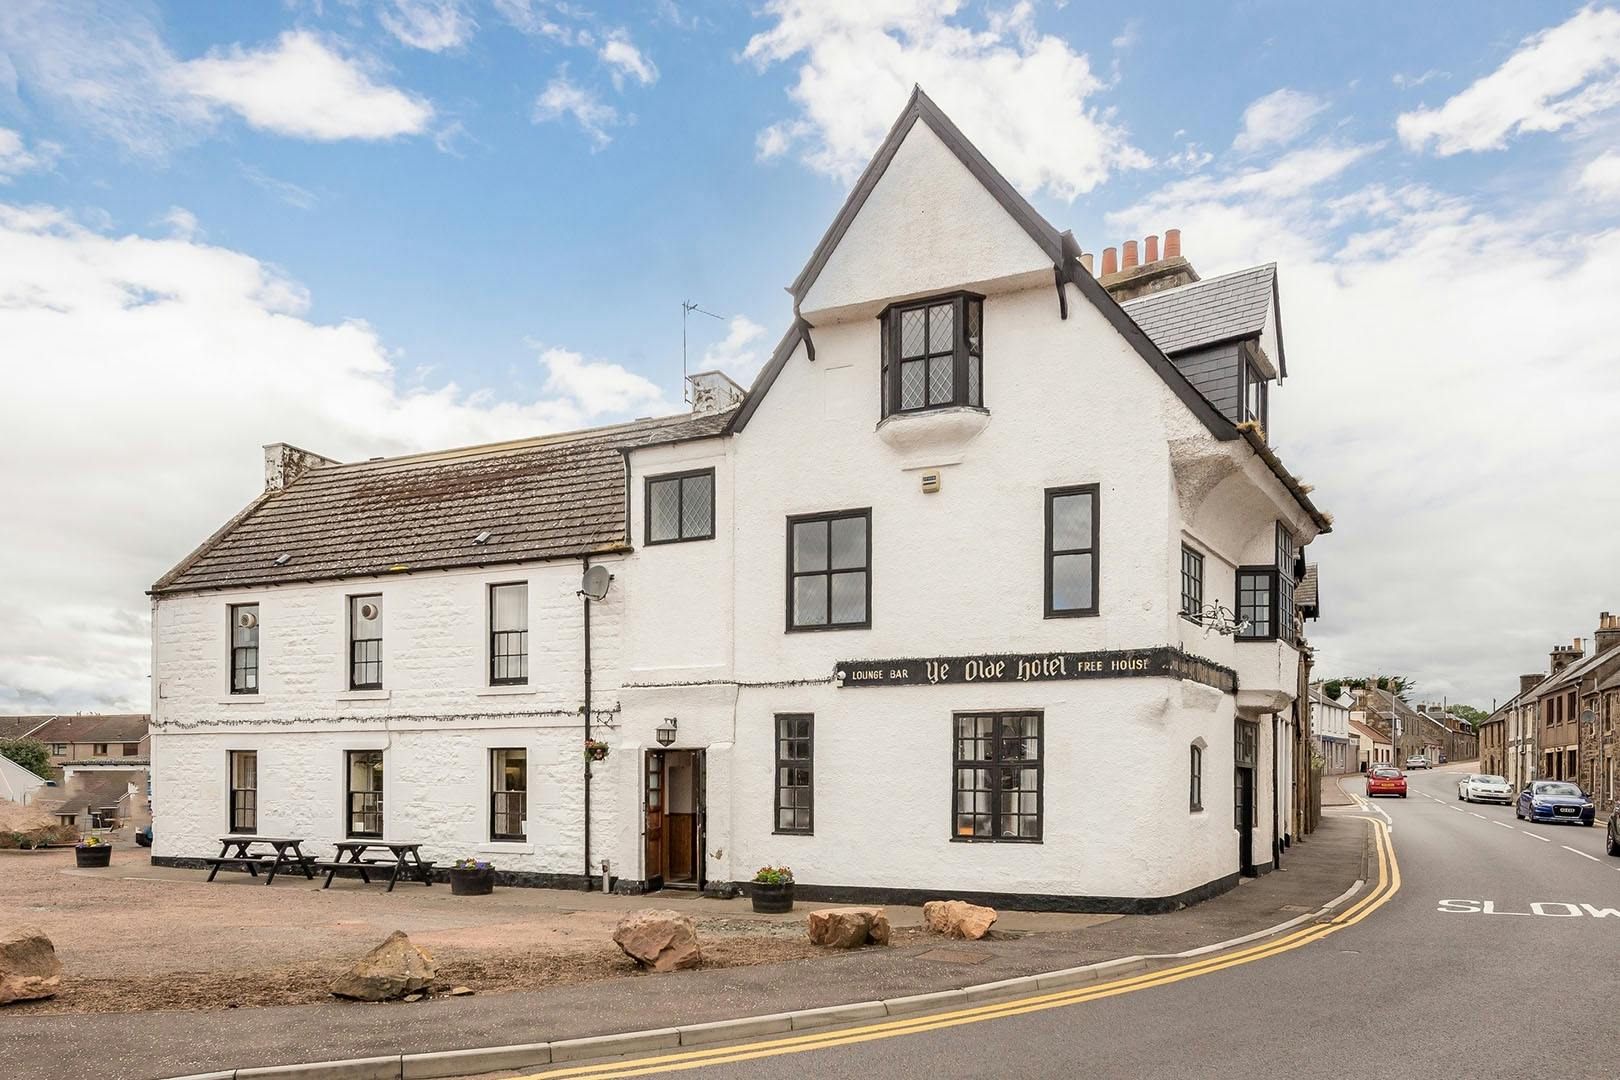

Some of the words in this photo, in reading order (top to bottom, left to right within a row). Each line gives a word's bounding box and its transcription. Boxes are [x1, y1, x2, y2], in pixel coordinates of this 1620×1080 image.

[852, 670, 884, 680] LOUNGE
[890, 669, 908, 679] BAR
[965, 660, 1005, 681] Olde
[1078, 661, 1103, 672] FREE
